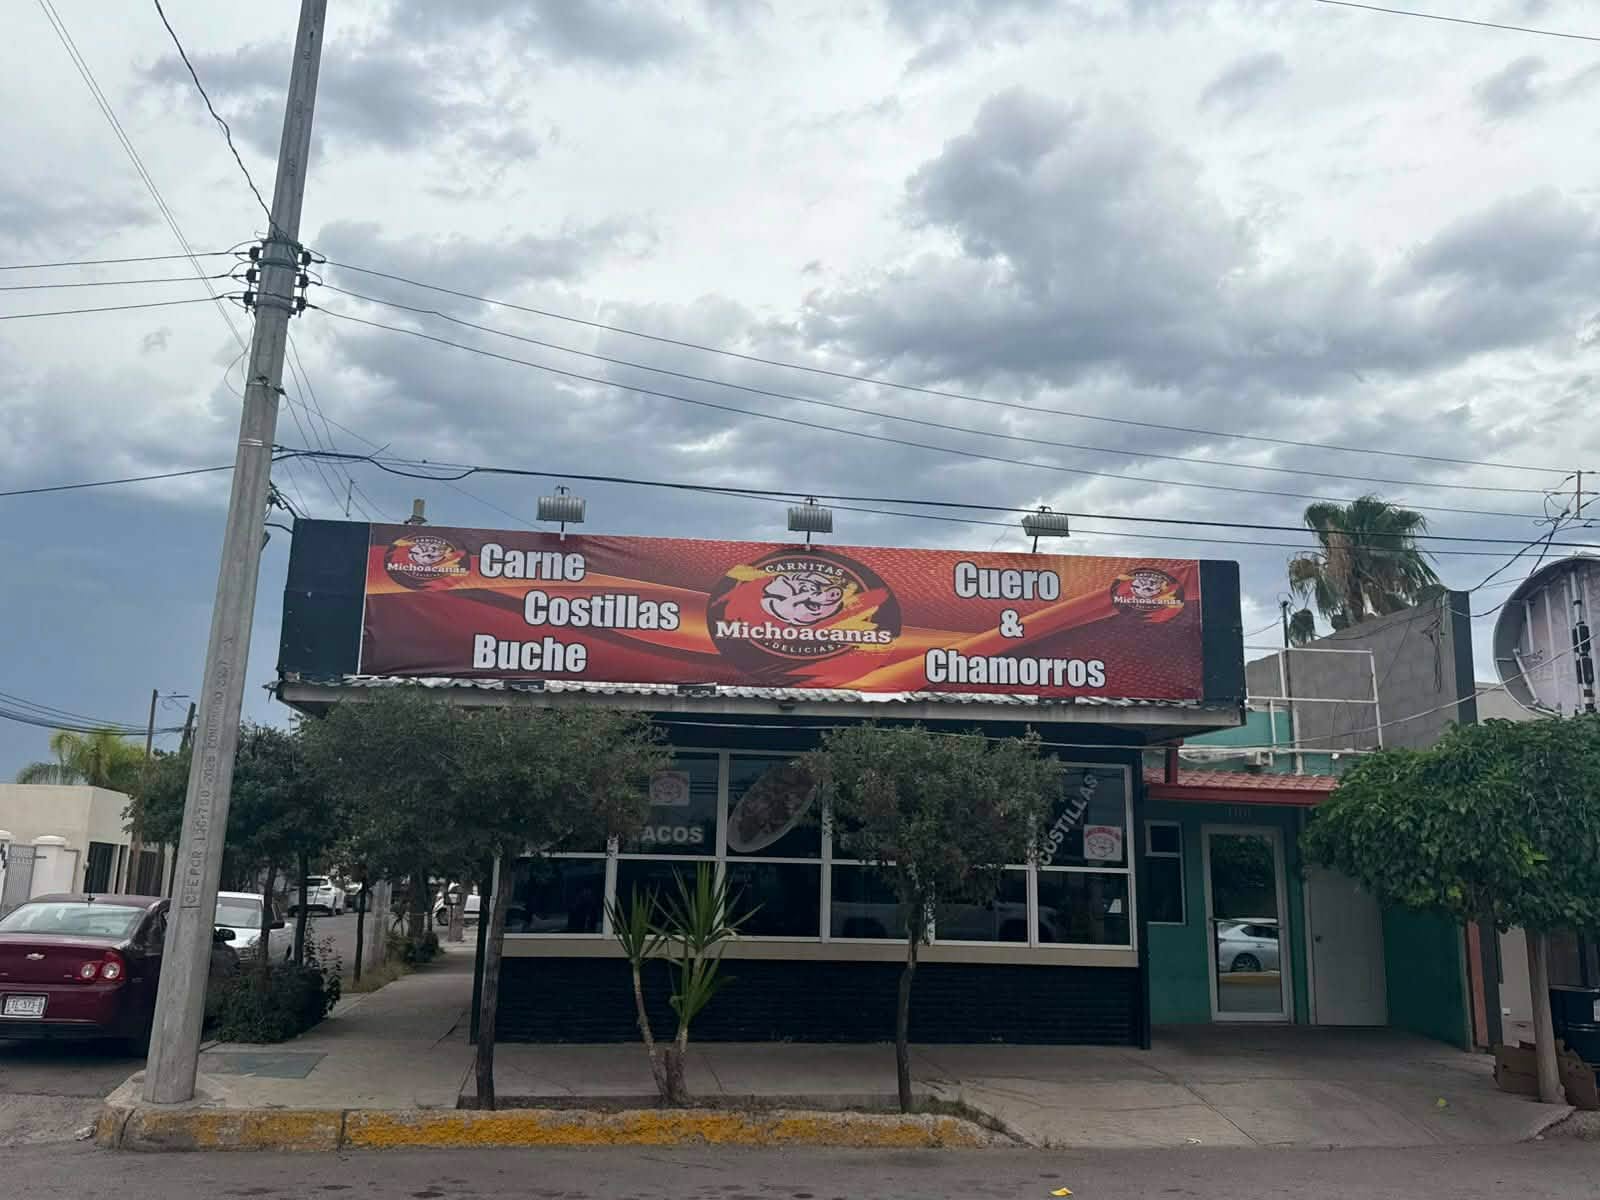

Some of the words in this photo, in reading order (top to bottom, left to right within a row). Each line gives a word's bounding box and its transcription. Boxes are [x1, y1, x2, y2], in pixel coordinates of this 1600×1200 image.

[387, 562, 467, 574] Michoacanas
[479, 543, 585, 581] Carne
[765, 561, 844, 577] CARNITAS
[954, 561, 1060, 600] Cuero
[524, 590, 680, 631] Costillas
[1113, 595, 1183, 605] Michoacanas
[715, 620, 892, 644] Michoacanas
[1000, 609, 1024, 639] &
[472, 634, 588, 673] Buche
[772, 643, 834, 654] DELICIAS
[925, 648, 1106, 688] Chamorros
